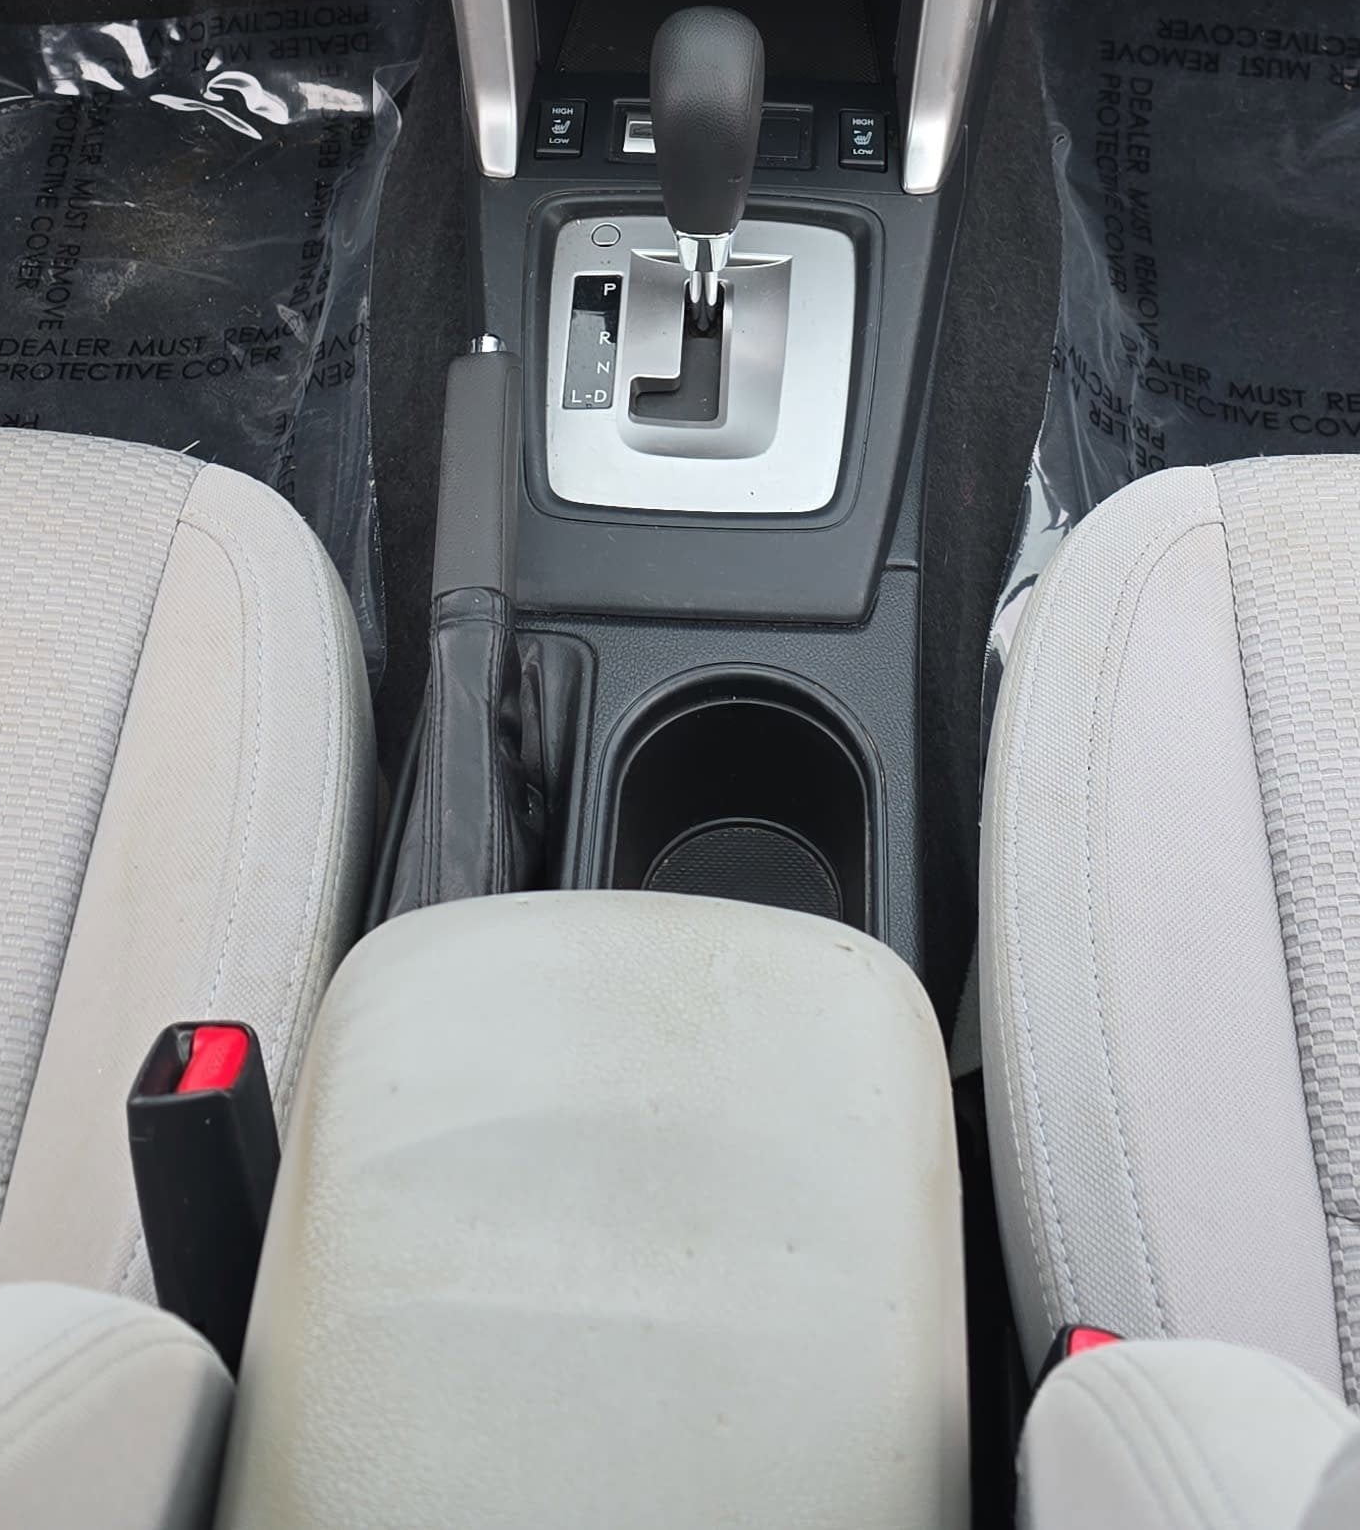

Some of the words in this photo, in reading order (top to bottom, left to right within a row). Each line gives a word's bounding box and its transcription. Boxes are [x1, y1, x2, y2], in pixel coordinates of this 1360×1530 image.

[270, 32, 369, 59] DEALER
[1156, 19, 1257, 49] COVER
[1099, 40, 1219, 73] REMOVE
[1237, 56, 1310, 81] MUST
[551, 107, 574, 116] HIGH
[852, 118, 875, 127] HIGH
[1127, 77, 1153, 173] DEALER
[549, 137, 570, 145] LOW
[852, 148, 874, 156] LOW
[1095, 73, 1124, 214] PROTECTIVE
[63, 178, 96, 231] MUST
[1129, 188, 1153, 243] MUST
[15, 216, 53, 290] COVER
[1104, 214, 1126, 294] COVER
[38, 243, 80, 331] REMOVE
[603, 283, 617, 296] P
[1134, 254, 1159, 350] REMOVE
[127, 334, 207, 357] MUST
[599, 332, 611, 344] R
[181, 344, 284, 380] COVER
[597, 361, 610, 374] N
[1228, 381, 1306, 408] MUST
